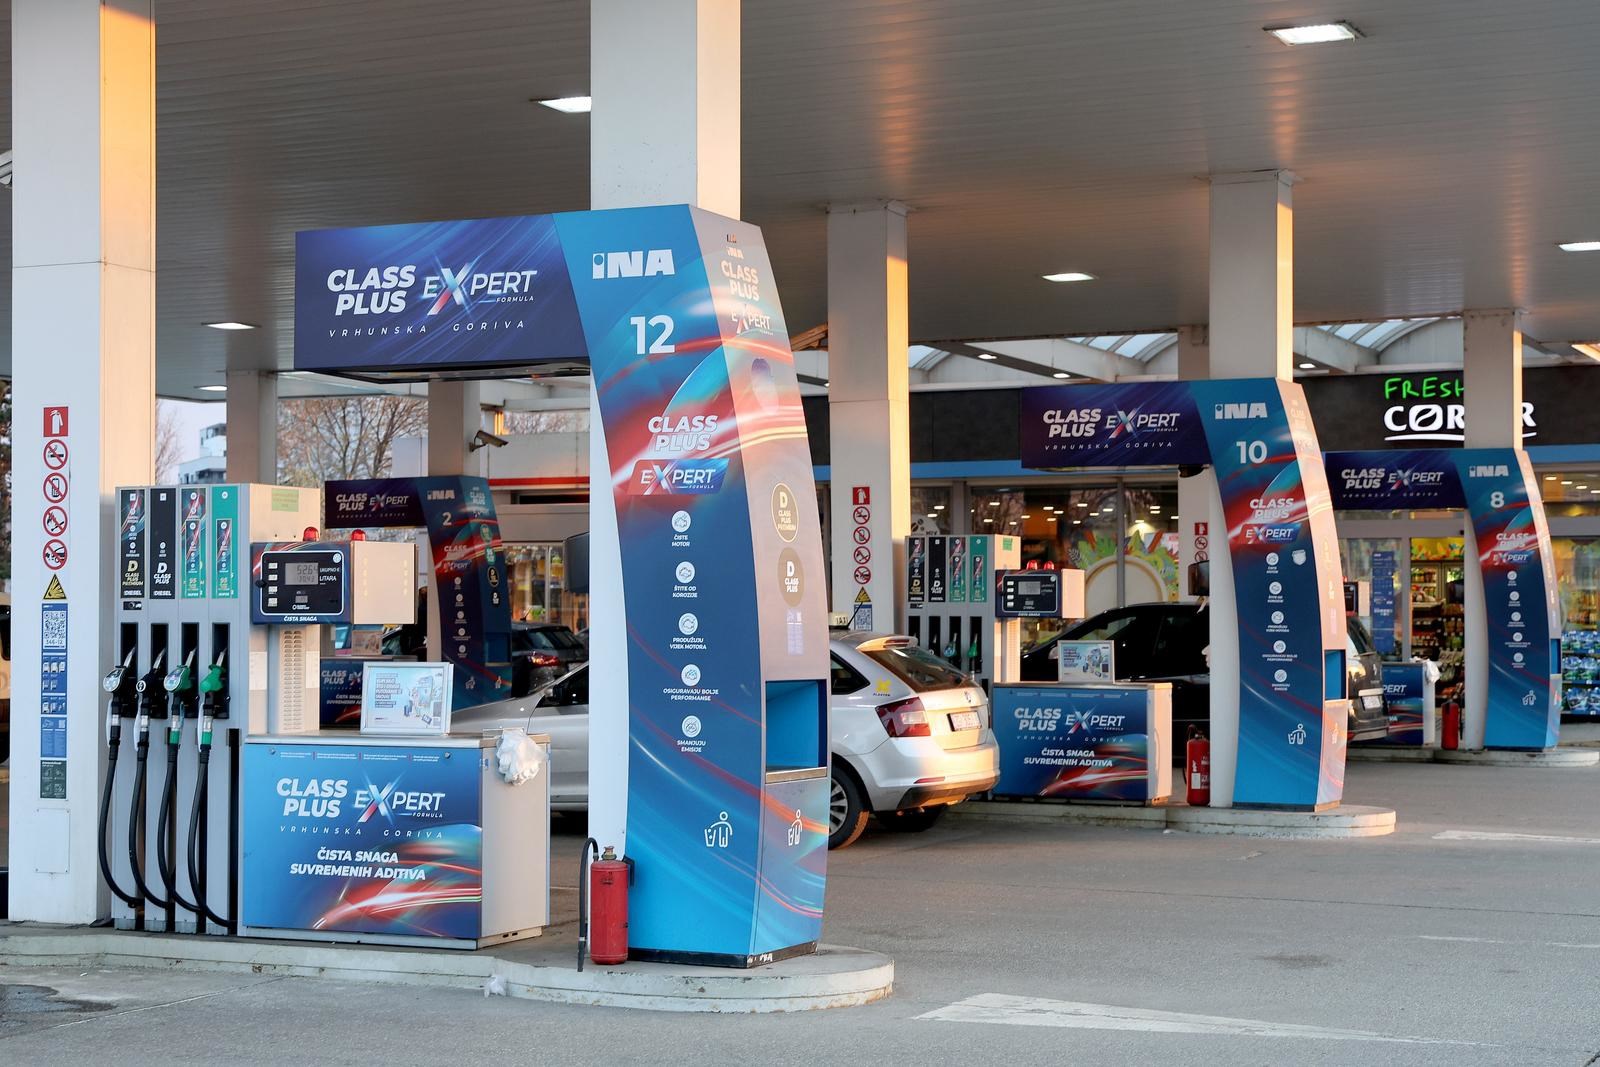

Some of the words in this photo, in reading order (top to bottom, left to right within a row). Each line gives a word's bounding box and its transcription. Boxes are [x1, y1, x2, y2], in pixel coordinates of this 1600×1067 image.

[327, 265, 416, 292] CLASS
[721, 260, 759, 285] CLASS
[423, 262, 538, 316] EXPERT
[730, 280, 759, 301] PLUS
[335, 291, 407, 316] PLUS
[496, 295, 534, 304] FORMULA
[329, 325, 427, 338] VRHUNSKA
[453, 321, 524, 333] GORIVA
[630, 315, 675, 355] 12
[1043, 408, 1101, 424] CLASS
[1106, 408, 1180, 438] EXPERT
[647, 415, 719, 435] CLASS
[1048, 423, 1096, 438] PLUS
[655, 434, 711, 453] PLUS
[1236, 440, 1267, 464] 10
[640, 464, 716, 495] EXPERT
[1341, 468, 1385, 479] CLASS
[1388, 468, 1444, 490] EXPERT
[1345, 479, 1381, 490] PLUS
[336, 493, 367, 503] CLASS
[369, 494, 409, 511] EXPERT
[780, 492, 788, 508] D
[1249, 498, 1294, 509] CLASS
[1490, 491, 1504, 508] 8
[339, 502, 364, 511] PLUS
[778, 510, 791, 518] CLASS
[1254, 508, 1290, 519] PLUS
[442, 512, 452, 526] 2
[781, 516, 791, 524] PLUS
[1245, 526, 1294, 544] EXPERT
[1496, 533, 1529, 541] CLASS
[128, 560, 138, 572] D
[157, 562, 167, 573] D
[787, 561, 794, 577] D
[785, 577, 799, 586] CLASS
[324, 677, 344, 685] PLUS
[1014, 708, 1061, 720] CLASS
[1019, 720, 1056, 731] PLUS
[1065, 711, 1125, 734] EXPERT
[1041, 747, 1065, 757] ČISTA
[1024, 757, 1078, 766] SUVREMENIH
[1079, 759, 1113, 767] ADITIVA
[276, 778, 348, 799] CLASS
[283, 799, 341, 818] PLUS
[354, 782, 445, 823] EXPERT
[280, 826, 362, 835] VRHUNSKA
[383, 829, 443, 838] GORIVA
[317, 847, 353, 862] ČISTA
[355, 850, 399, 864] SNAGA
[289, 863, 371, 878] SUVREMENIH
[374, 867, 426, 881] ADITIVA
